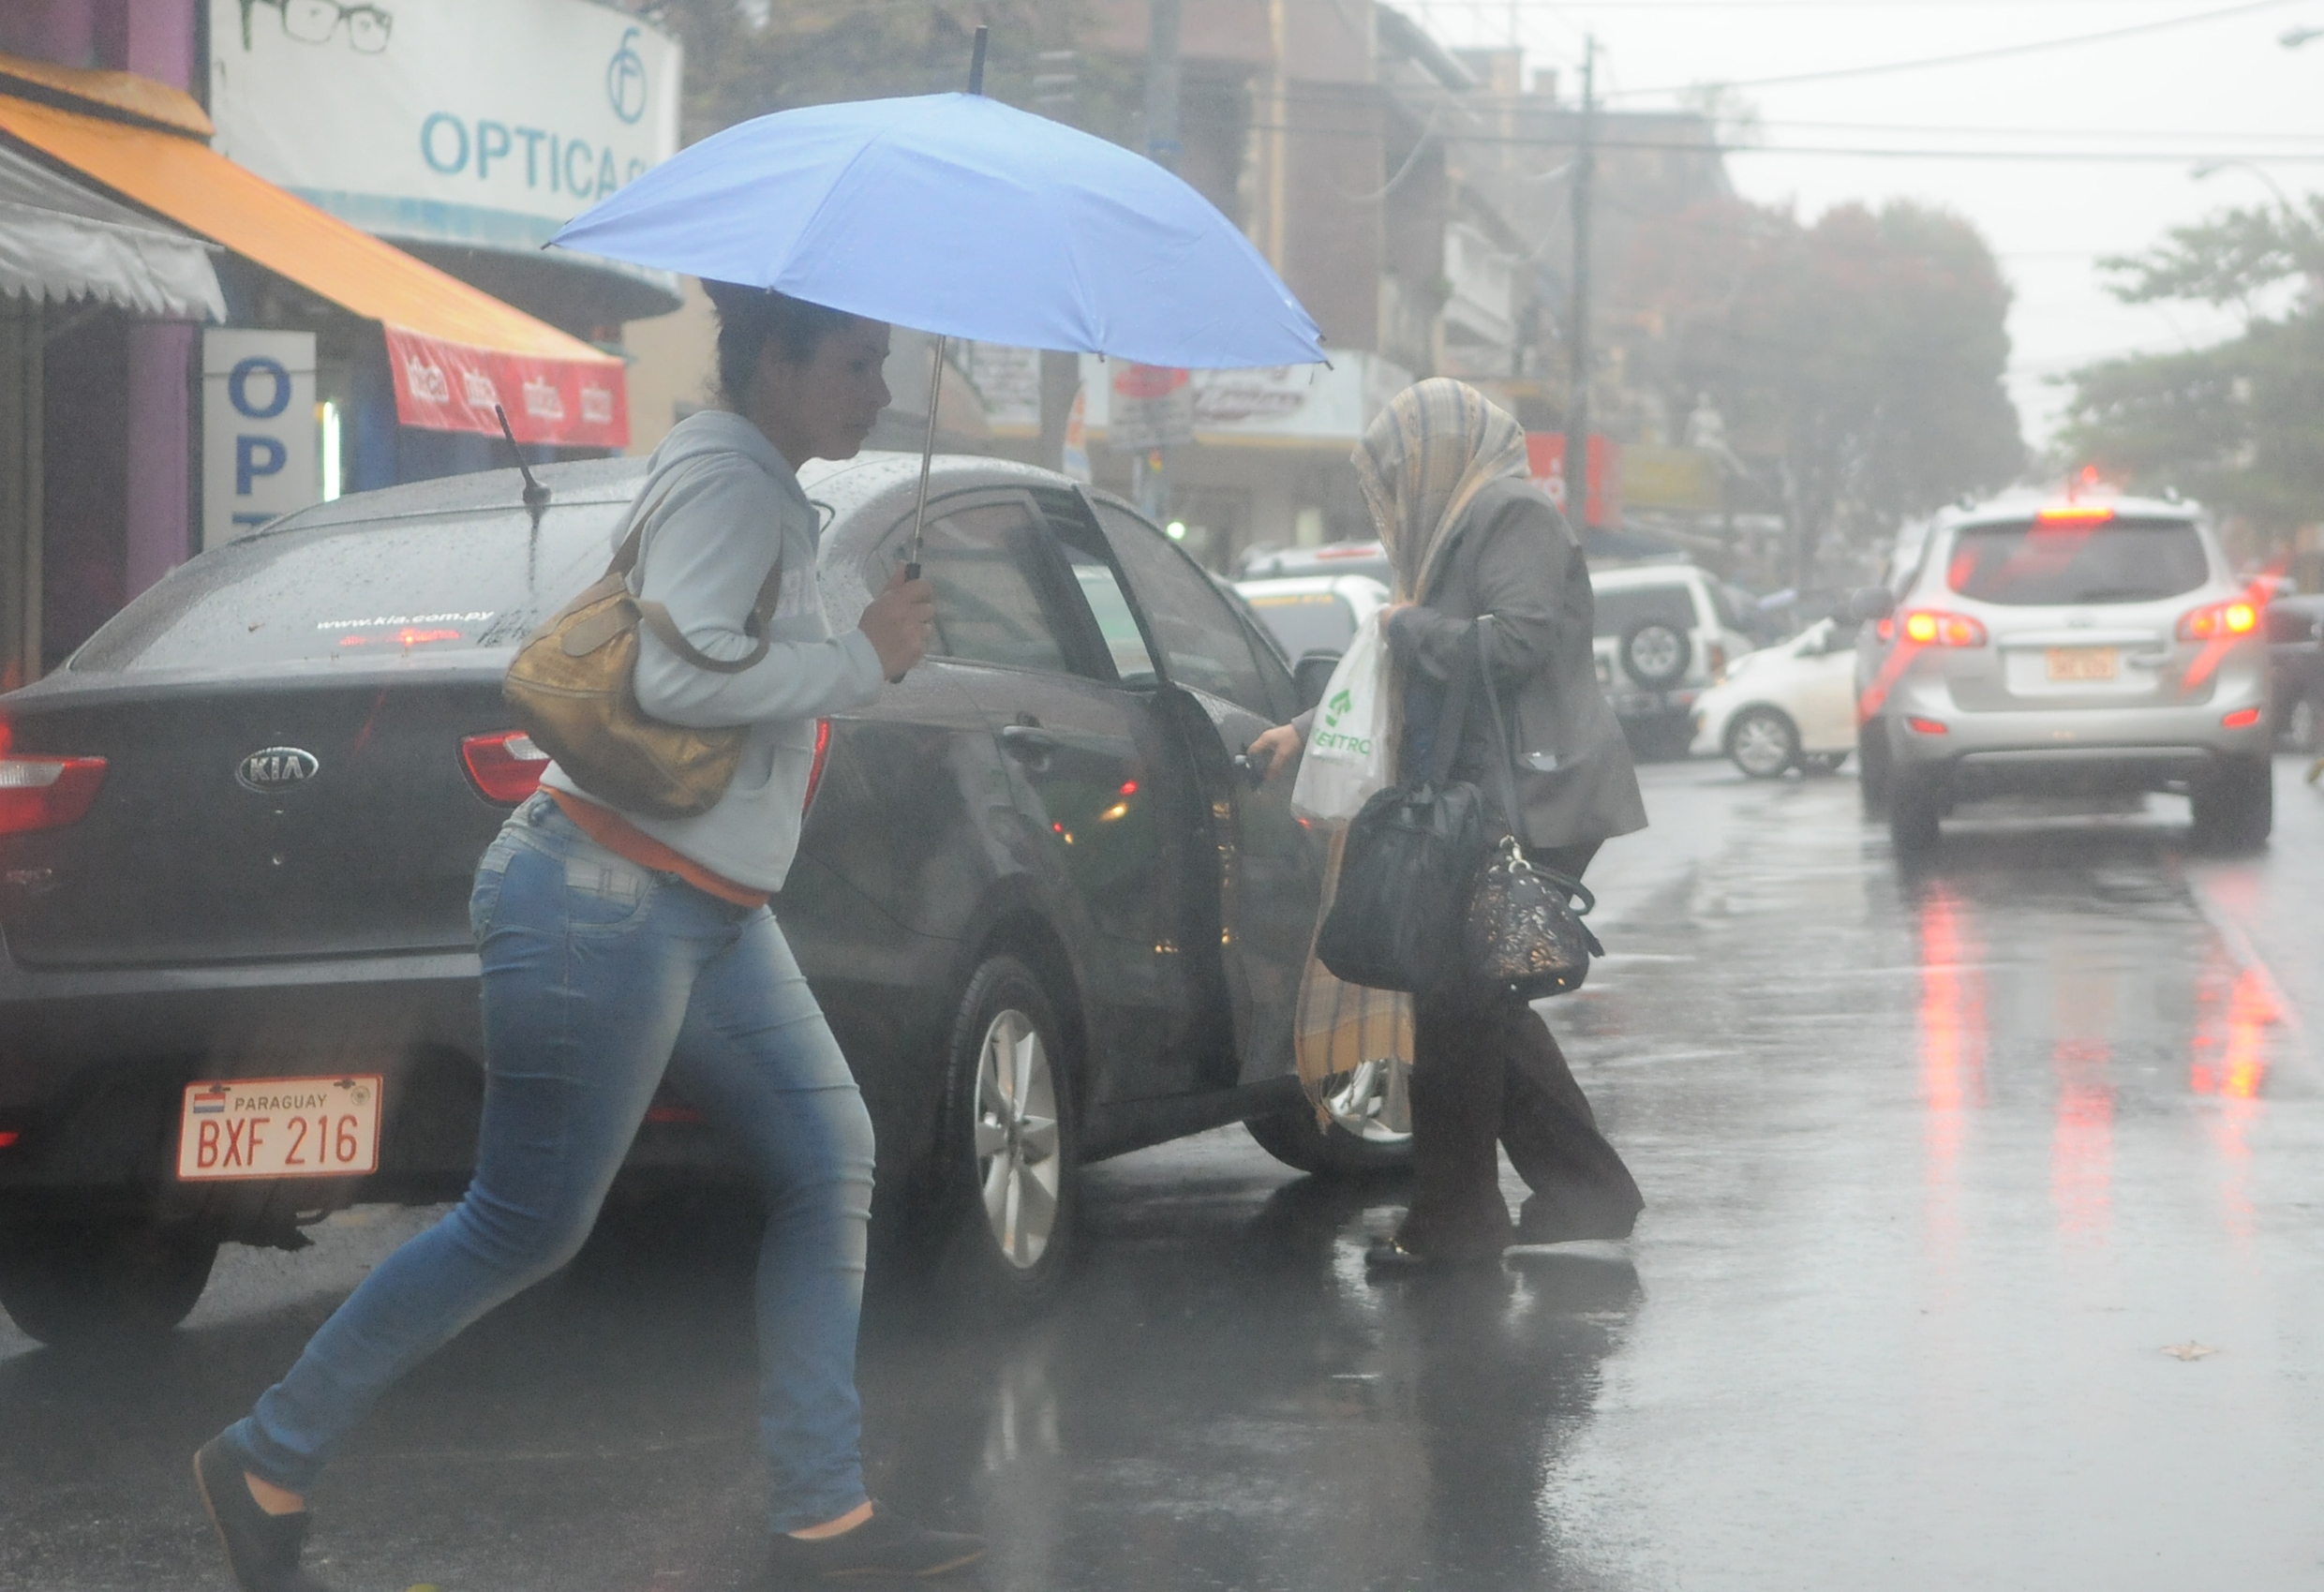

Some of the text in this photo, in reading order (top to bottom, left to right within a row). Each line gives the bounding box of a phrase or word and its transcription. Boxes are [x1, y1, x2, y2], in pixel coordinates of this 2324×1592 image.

[317, 611, 495, 630] www.kia.com.py
[248, 755, 305, 781] KIA
[234, 1094, 328, 1112] PARAGUAY
[197, 1113, 359, 1169] BXF 216
